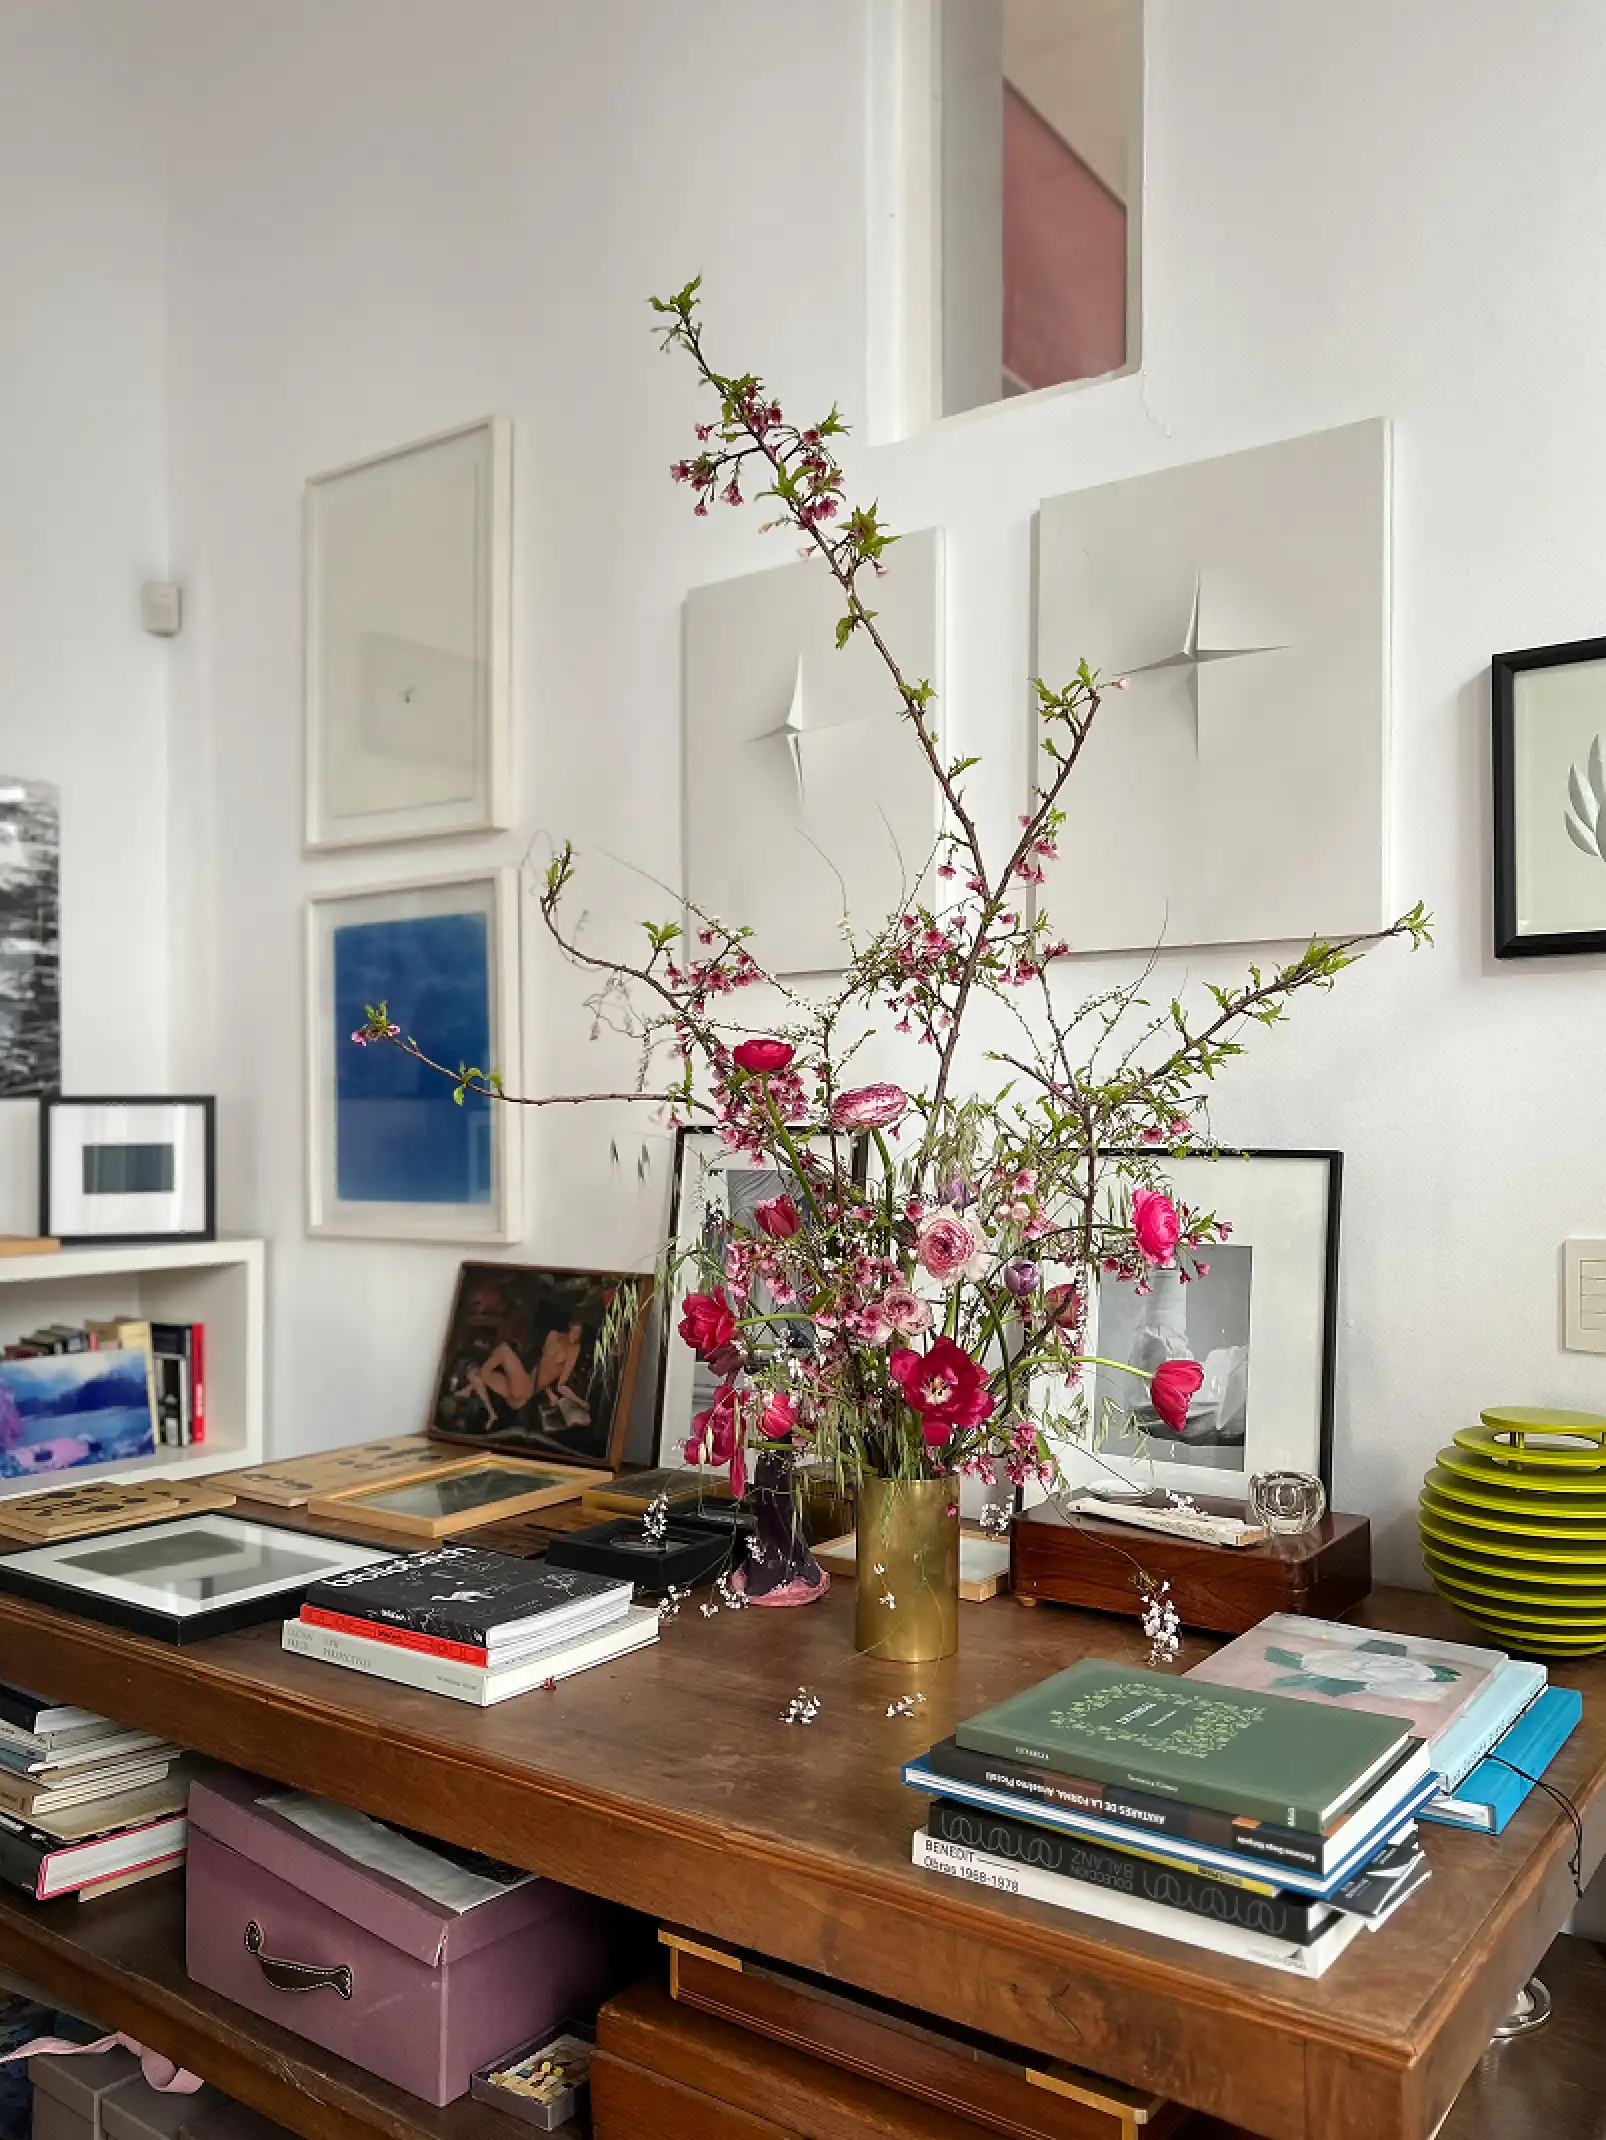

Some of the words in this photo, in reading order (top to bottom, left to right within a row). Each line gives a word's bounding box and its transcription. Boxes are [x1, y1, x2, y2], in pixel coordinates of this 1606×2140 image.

[1104, 1801, 1117, 1813] DE
[924, 1839, 975, 1863] BENEDIT
[923, 1855, 957, 1873] Obras
